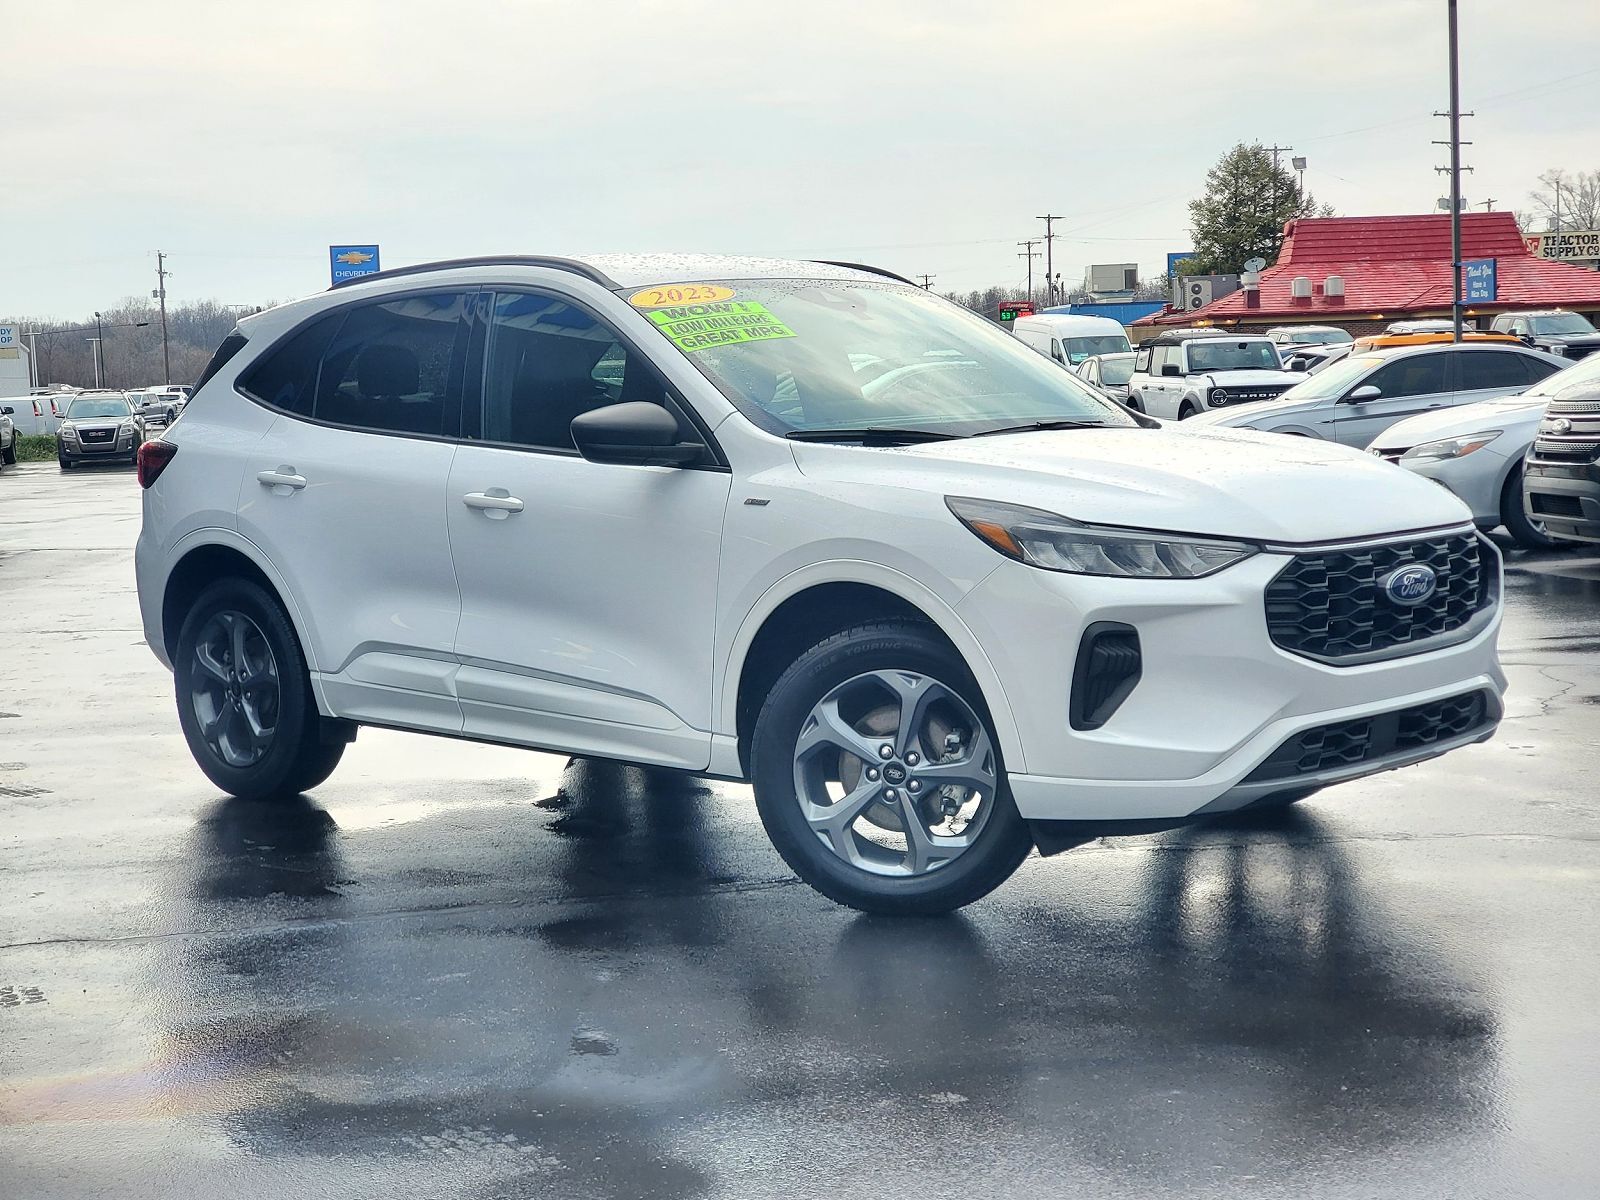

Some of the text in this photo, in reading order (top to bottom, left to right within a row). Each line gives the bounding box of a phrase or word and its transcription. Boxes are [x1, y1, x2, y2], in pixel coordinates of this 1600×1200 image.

[1543, 246, 1585, 257] SUPPLY
[1467, 264, 1492, 278] Thank You
[650, 286, 717, 305] 2023
[661, 302, 735, 320] WOW
[668, 313, 773, 337] LOW MILEAGE
[680, 325, 786, 348] GREAT MPG
[1401, 573, 1428, 596] Ford
